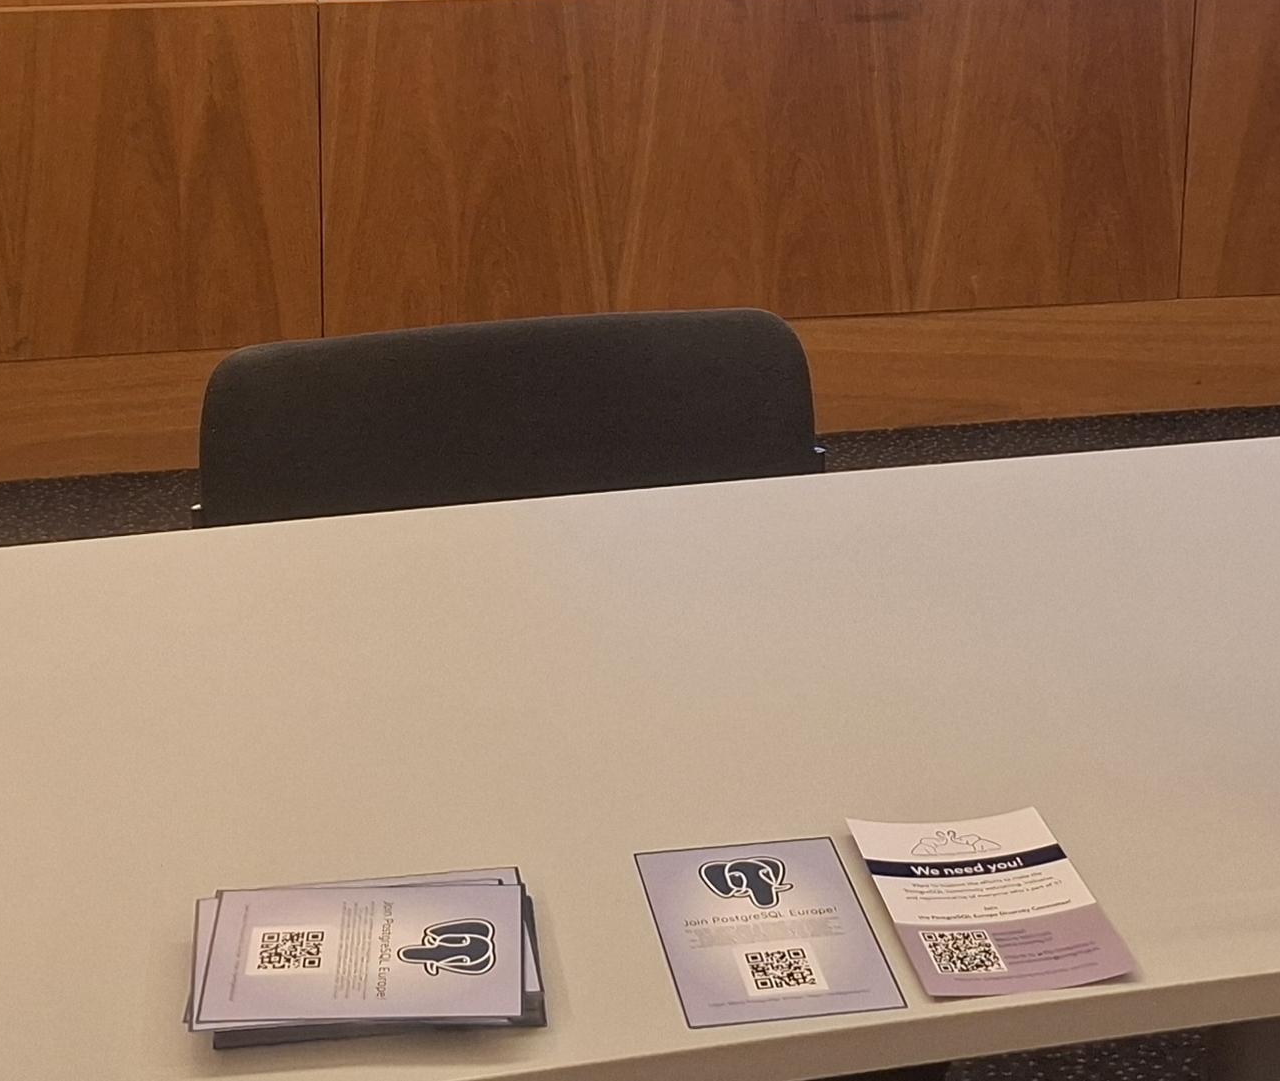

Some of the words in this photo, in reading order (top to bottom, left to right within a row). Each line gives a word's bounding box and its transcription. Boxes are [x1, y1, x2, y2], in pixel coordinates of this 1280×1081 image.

[910, 865, 940, 876] We
[943, 862, 985, 876] need
[986, 857, 1024, 873] you!
[683, 918, 709, 928] Join
[712, 912, 784, 924] PostgreSQL
